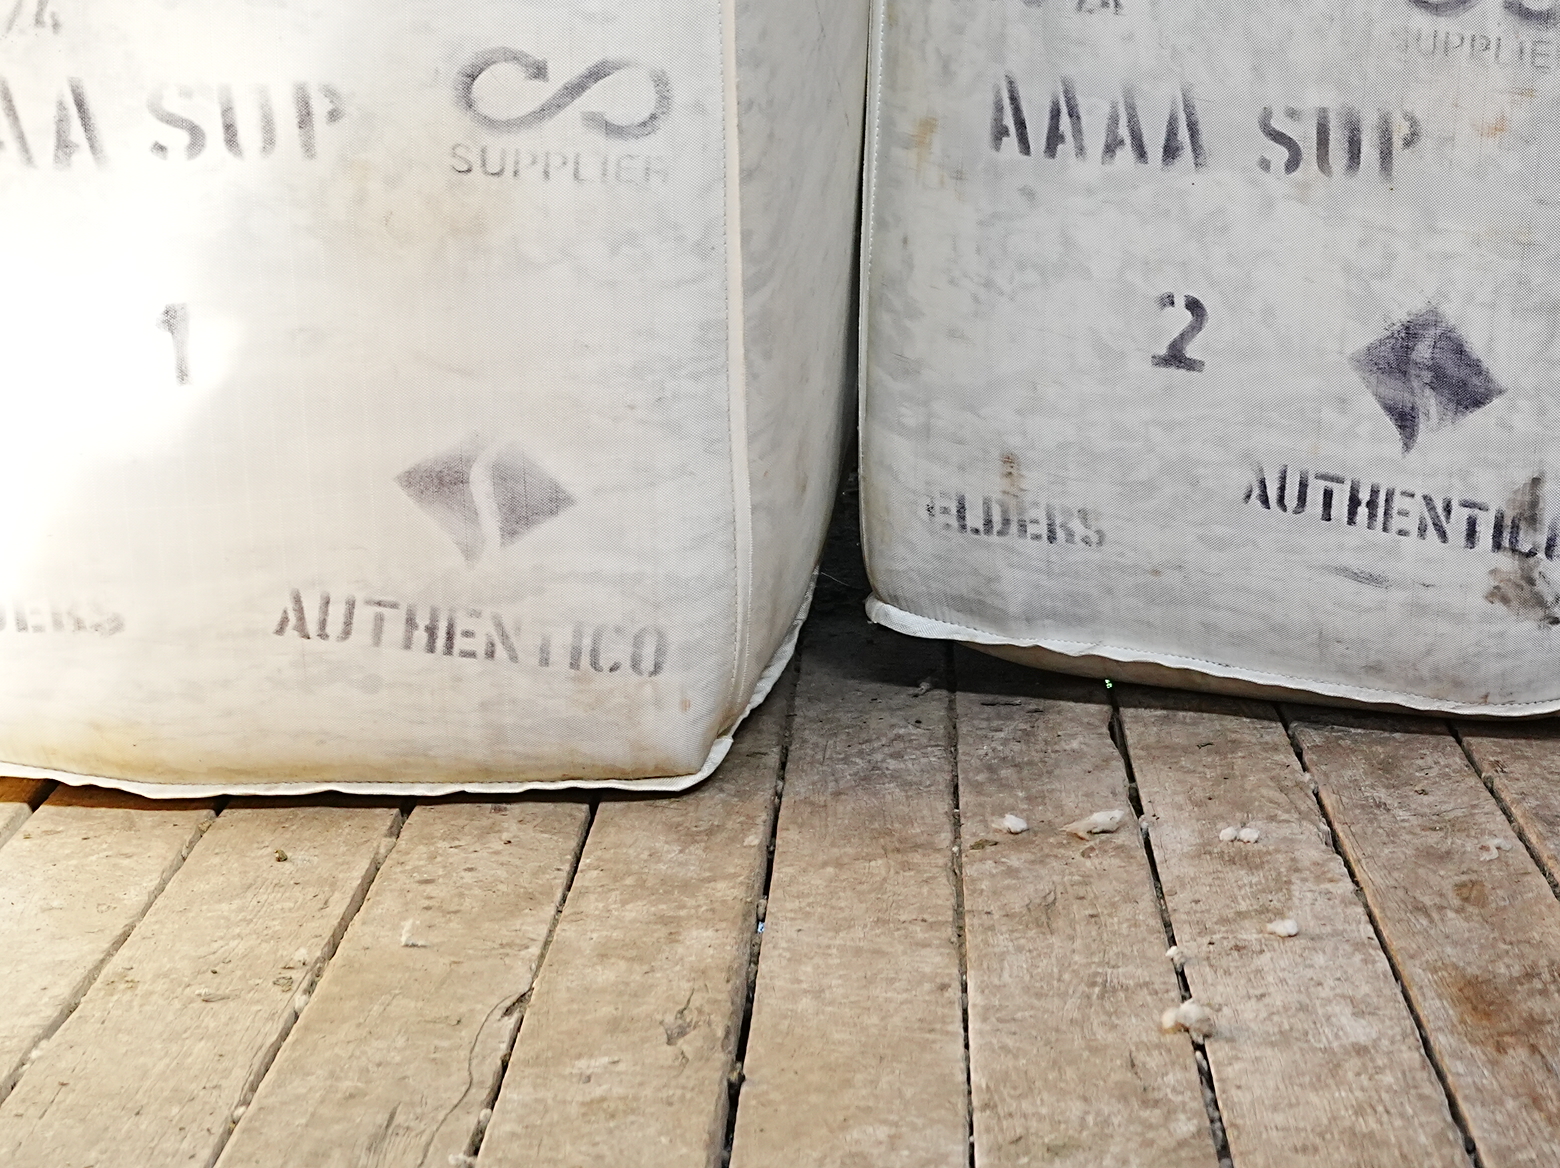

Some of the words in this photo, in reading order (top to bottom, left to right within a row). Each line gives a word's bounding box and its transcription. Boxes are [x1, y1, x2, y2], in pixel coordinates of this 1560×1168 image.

[147, 81, 345, 161] SUP
[990, 74, 1207, 170] AAAA
[1256, 105, 1421, 180] SUP
[450, 141, 671, 184] SUPPLIER
[1151, 292, 1210, 373] 2
[925, 488, 1107, 549] ELDERS
[273, 587, 671, 679] AUTHENTICO
